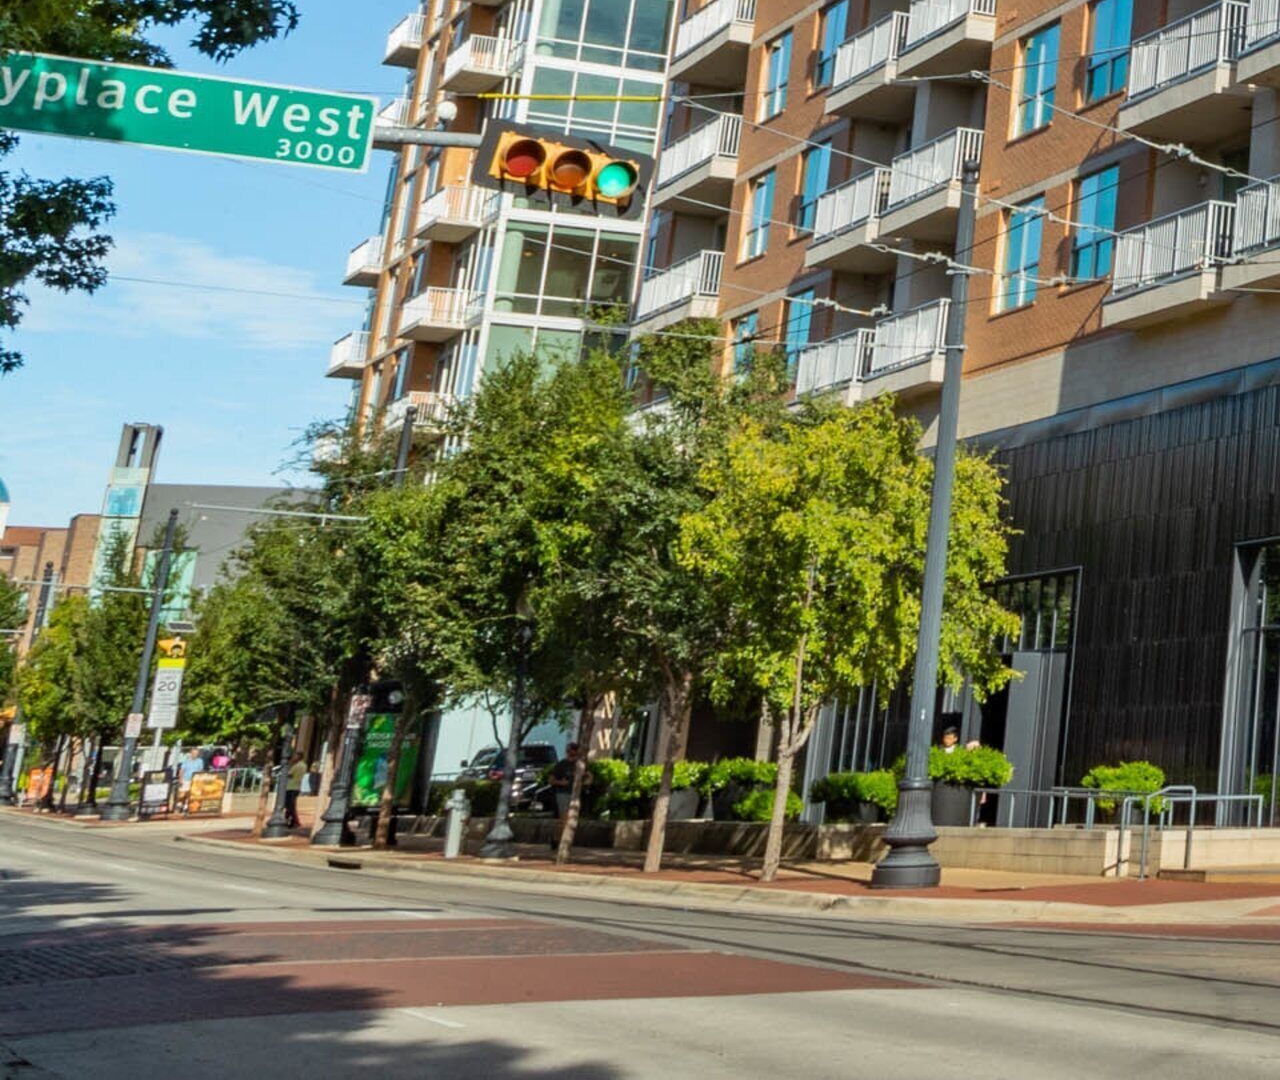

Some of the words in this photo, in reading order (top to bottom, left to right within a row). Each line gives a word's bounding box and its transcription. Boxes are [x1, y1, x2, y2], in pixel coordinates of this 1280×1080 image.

[233, 89, 366, 140] West
[275, 138, 356, 165] 3000
[157, 680, 177, 692] 20
